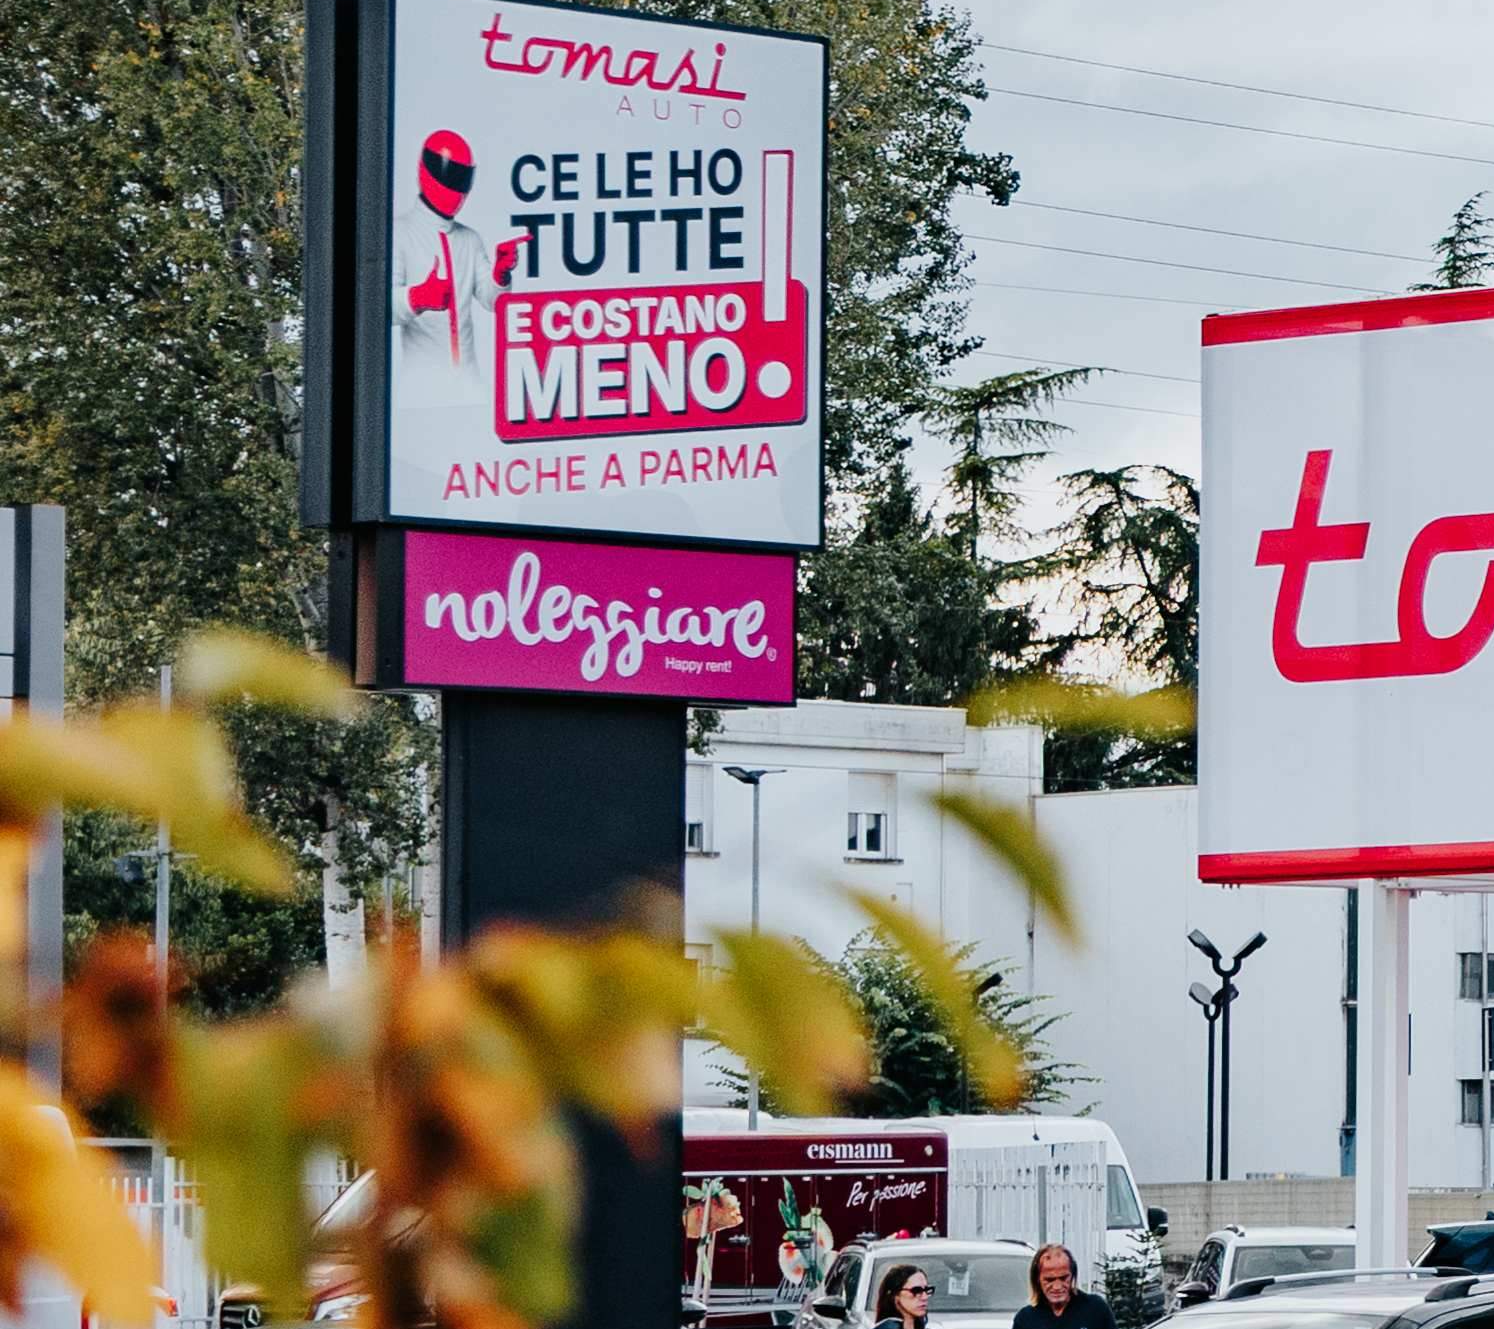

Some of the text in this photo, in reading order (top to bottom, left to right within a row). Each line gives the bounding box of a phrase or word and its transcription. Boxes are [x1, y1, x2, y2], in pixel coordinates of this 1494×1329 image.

[481, 13, 746, 100] tomasi
[616, 95, 743, 129] AUTO
[511, 148, 743, 202] CE LE HO
[510, 207, 744, 278] TUTTE
[506, 293, 747, 343] E COSTANO
[442, 443, 778, 500] ANCHE A PARMA
[424, 551, 768, 682] noleggiare
[665, 656, 732, 674] Happy rent!
[807, 1143, 893, 1159] eismann
[846, 1181, 868, 1208] Per
